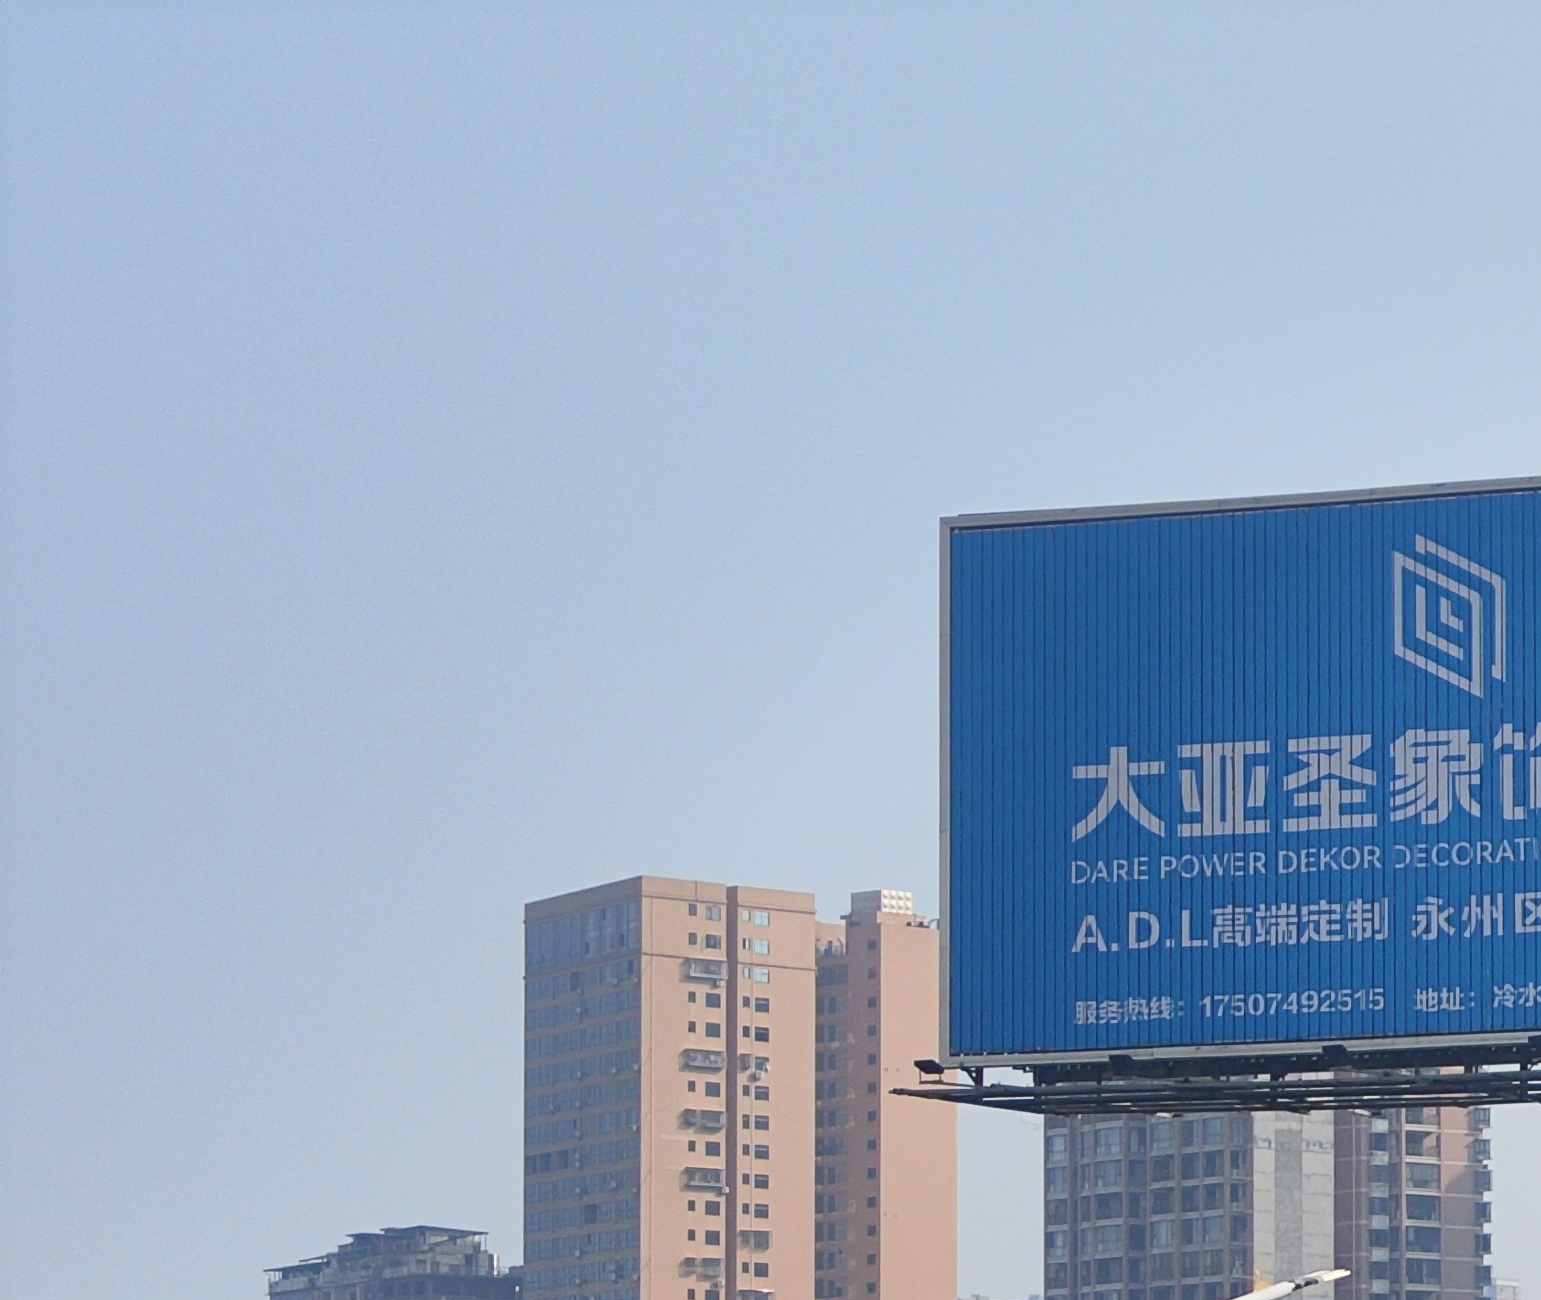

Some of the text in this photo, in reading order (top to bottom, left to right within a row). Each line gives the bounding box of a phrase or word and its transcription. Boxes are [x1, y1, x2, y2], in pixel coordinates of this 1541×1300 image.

[1071, 857, 1149, 884] DARE
[1160, 850, 1267, 879] POWER
[1278, 845, 1382, 874] DEKOR
